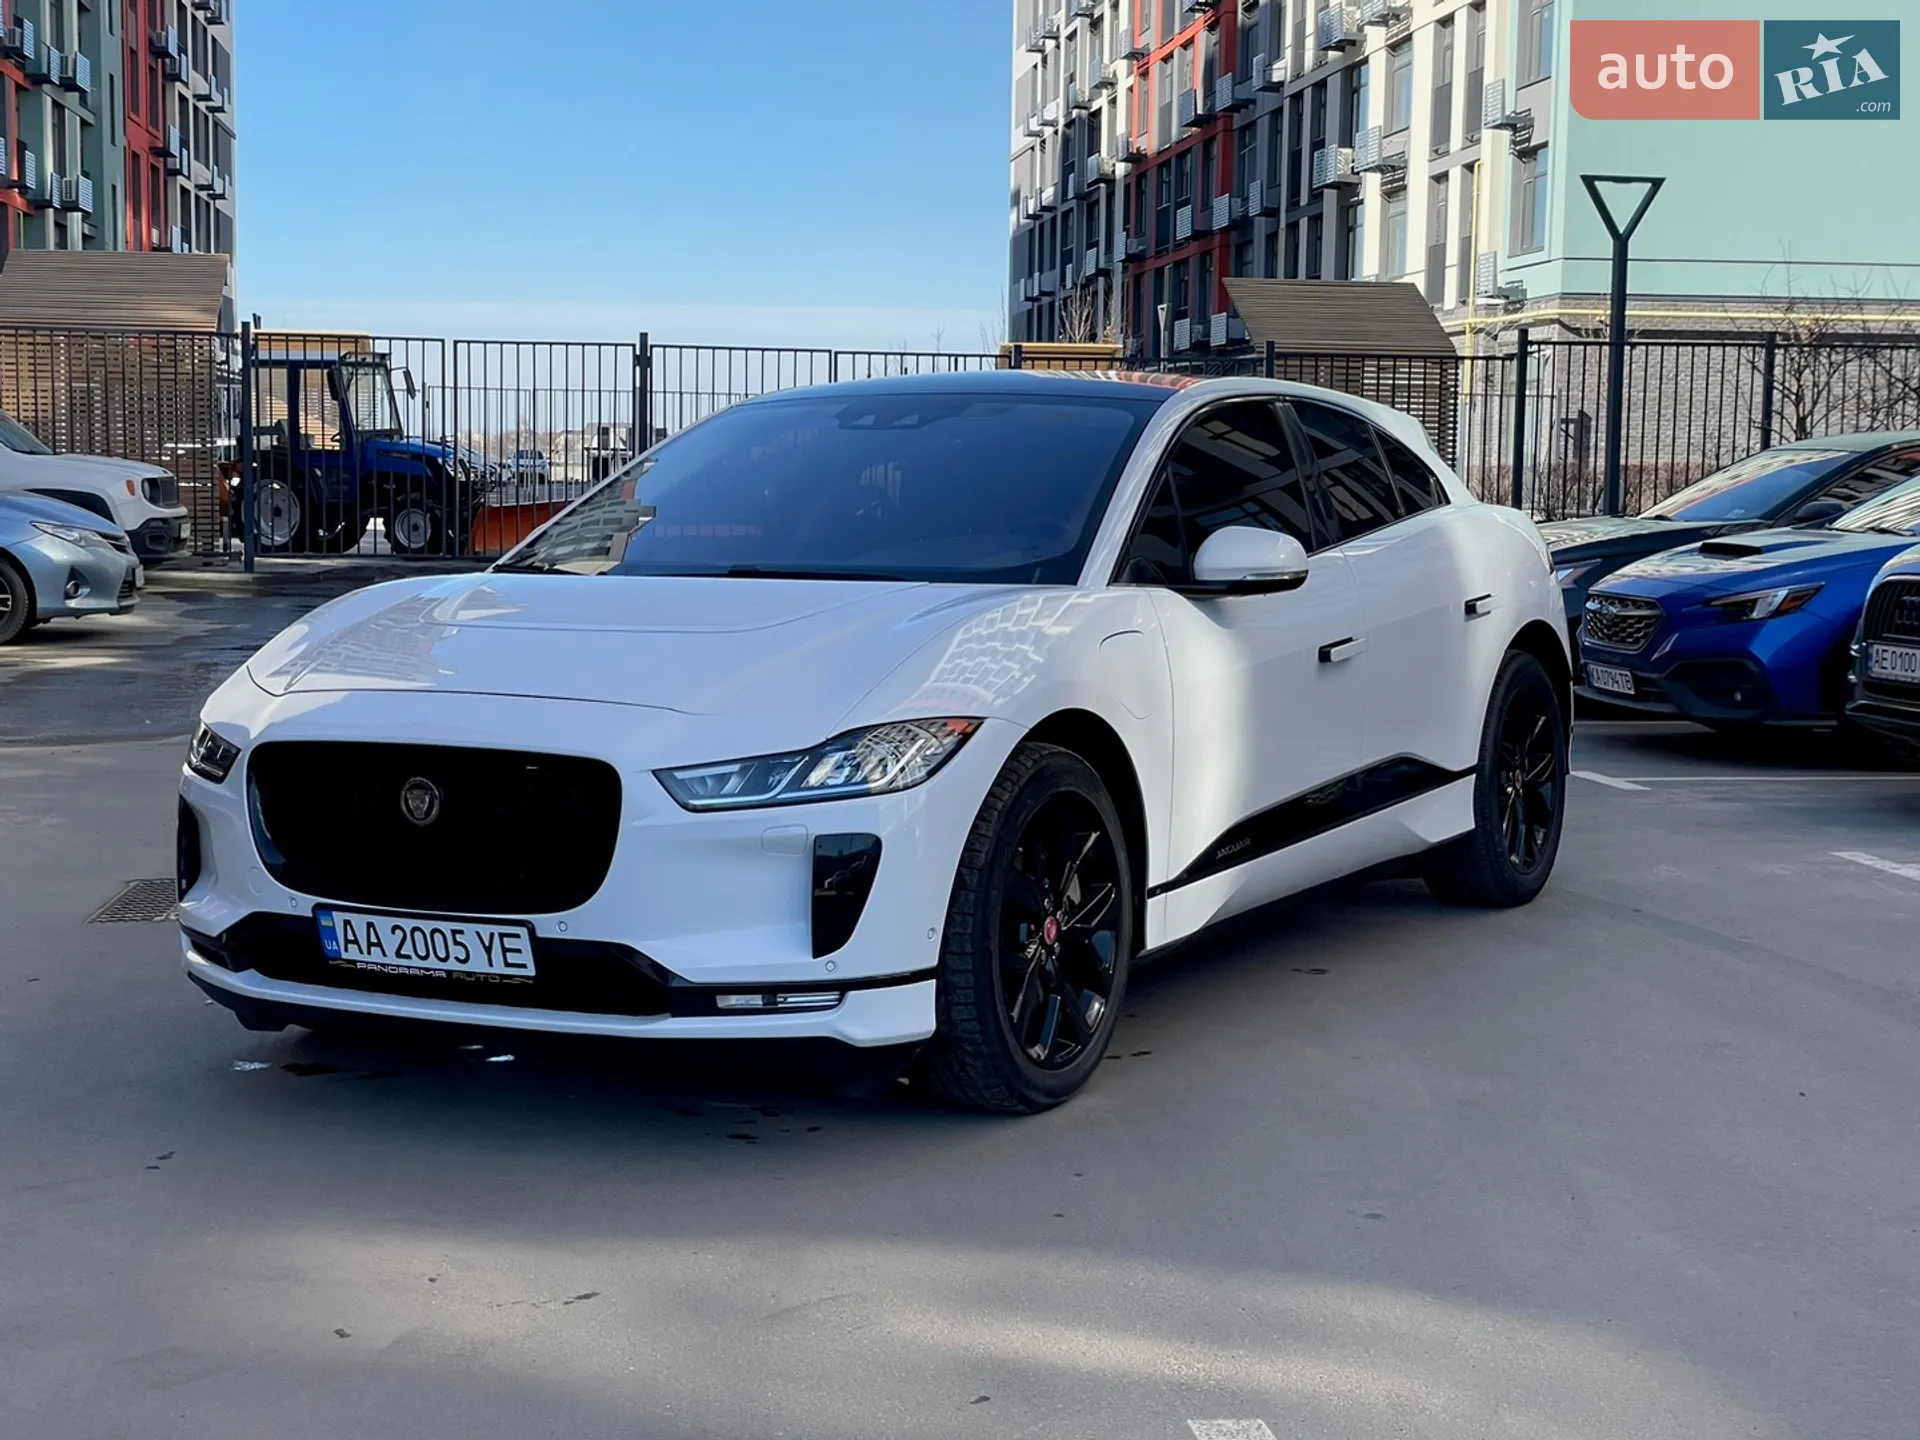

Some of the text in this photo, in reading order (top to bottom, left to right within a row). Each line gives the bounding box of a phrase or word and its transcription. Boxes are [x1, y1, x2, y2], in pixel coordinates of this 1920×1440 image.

[1215, 837, 1251, 860] JAGUAR
[324, 939, 339, 952] UA
[342, 919, 528, 970] AA 2005 YE
[356, 962, 500, 983] PANORAMA AUTO
